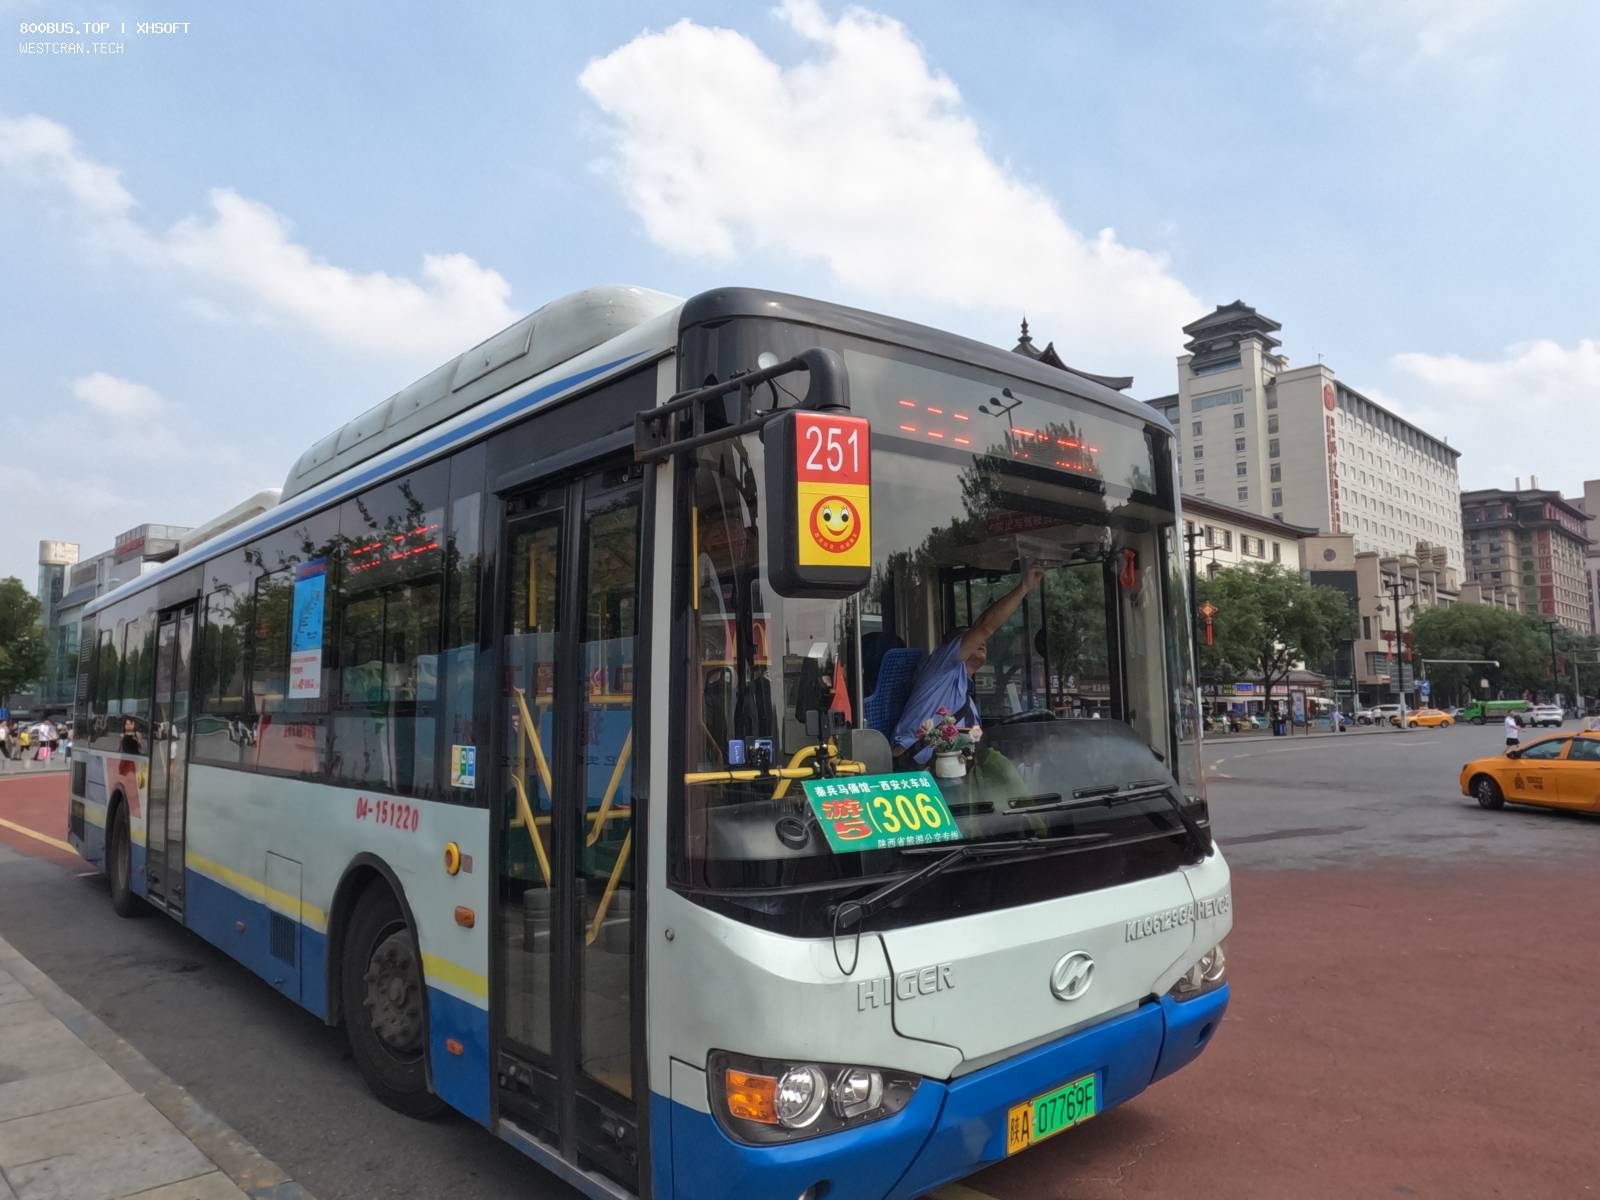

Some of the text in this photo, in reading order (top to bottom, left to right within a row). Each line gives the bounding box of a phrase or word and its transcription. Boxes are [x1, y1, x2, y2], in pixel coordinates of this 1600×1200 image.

[805, 425, 859, 473] 251
[866, 793, 951, 834] (306)
[857, 961, 955, 1012] HIGER
